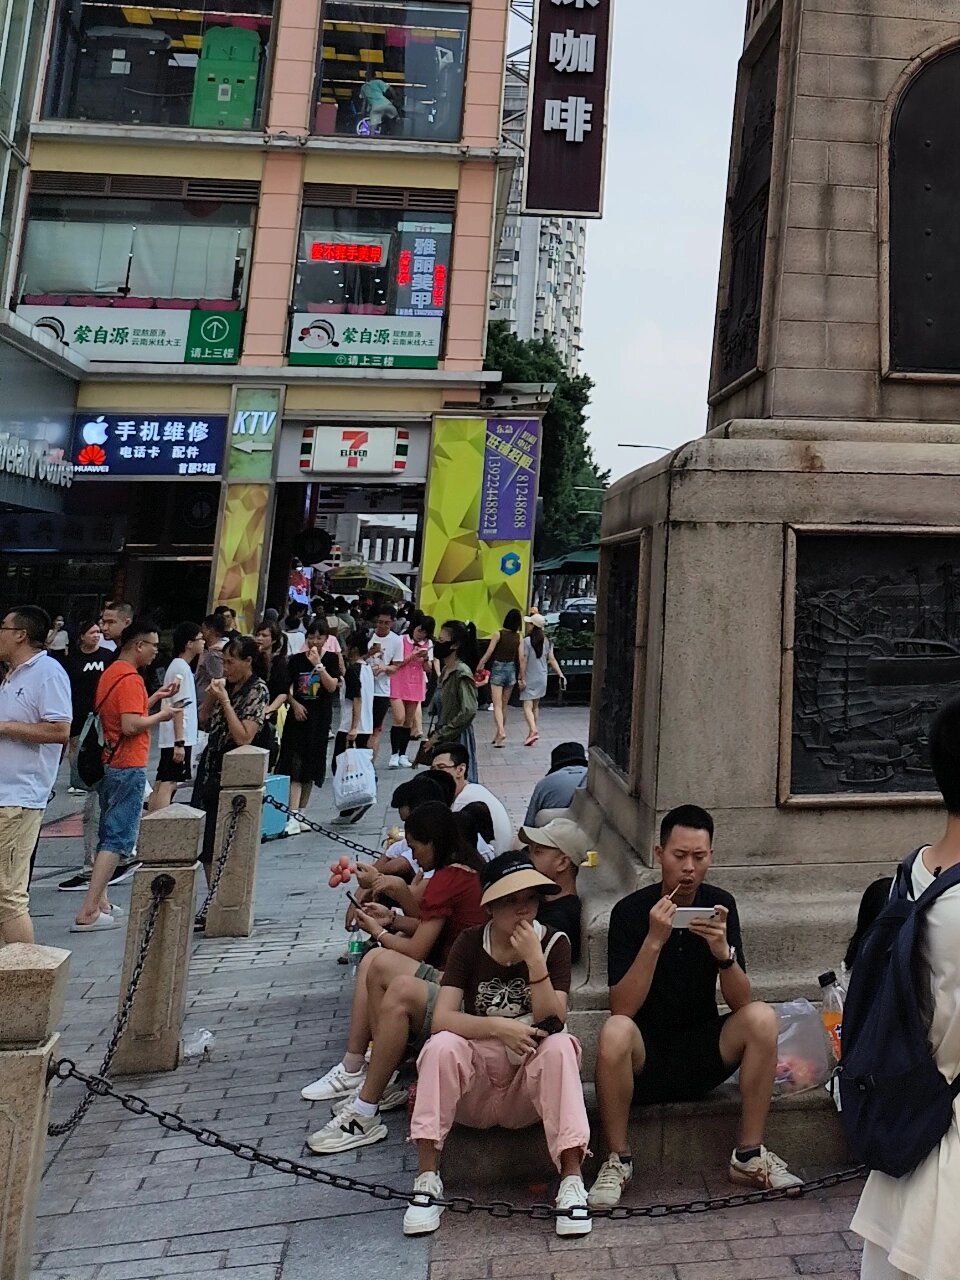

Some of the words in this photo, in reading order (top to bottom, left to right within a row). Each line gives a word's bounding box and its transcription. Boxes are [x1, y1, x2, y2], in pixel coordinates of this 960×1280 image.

[411, 239, 436, 308] 雅丽美甲
[73, 325, 130, 346] 蒙自源
[342, 326, 390, 345] 蒙自源
[190, 348, 235, 359] 请上三楼
[348, 355, 395, 367] 请上三楼
[114, 420, 209, 442] 手机维修
[232, 410, 277, 435] KTV
[120, 446, 160, 458] 电话卡
[171, 446, 199, 459] 配件
[74, 465, 109, 473] HUAWEI
